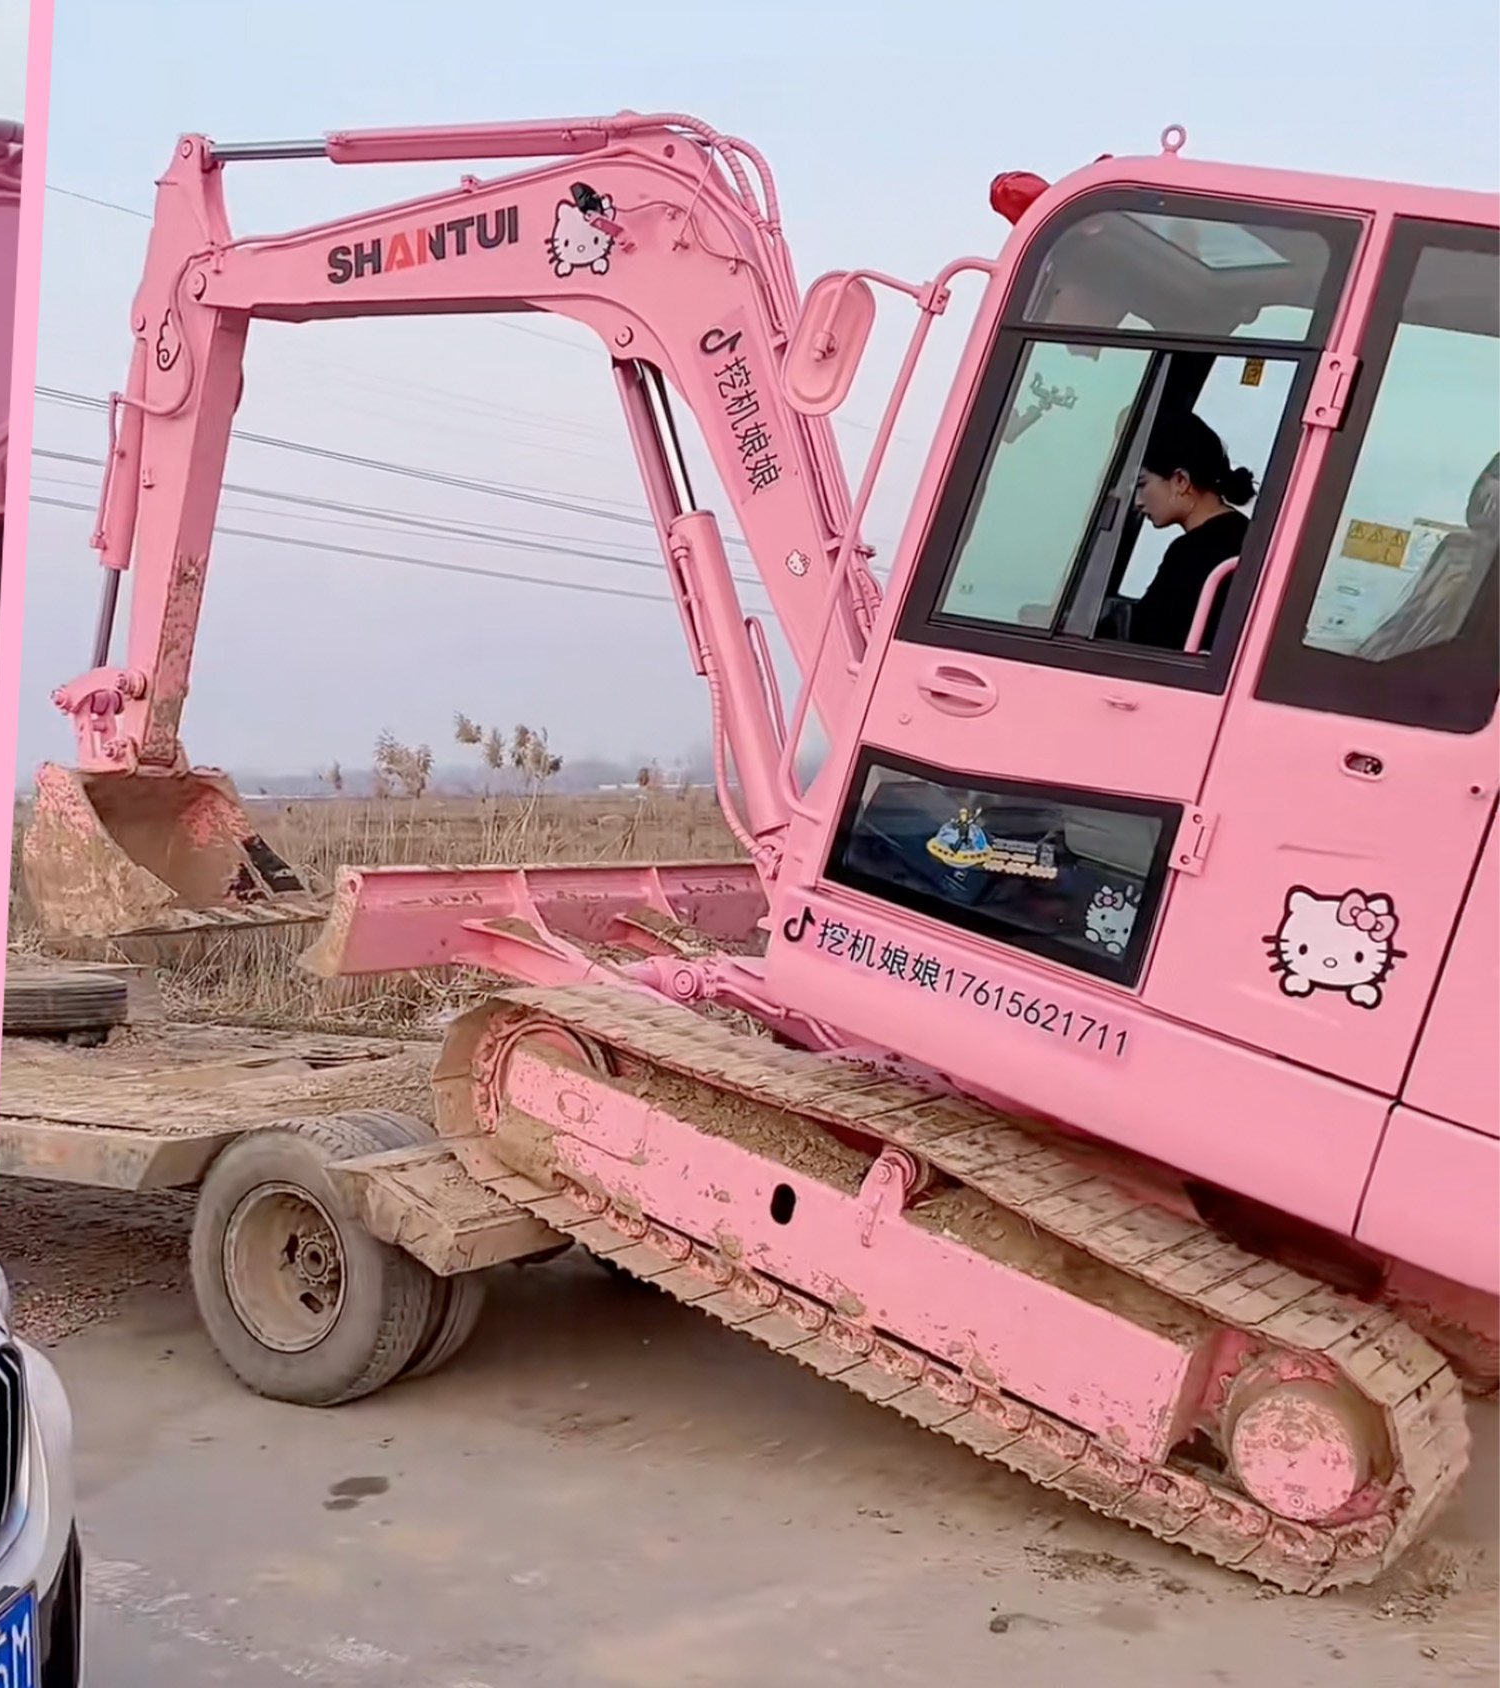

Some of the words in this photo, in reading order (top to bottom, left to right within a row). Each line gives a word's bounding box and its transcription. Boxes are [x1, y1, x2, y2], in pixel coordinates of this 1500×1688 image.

[327, 205, 519, 284] SHANTUI
[714, 356, 782, 495] 挖机娘娘
